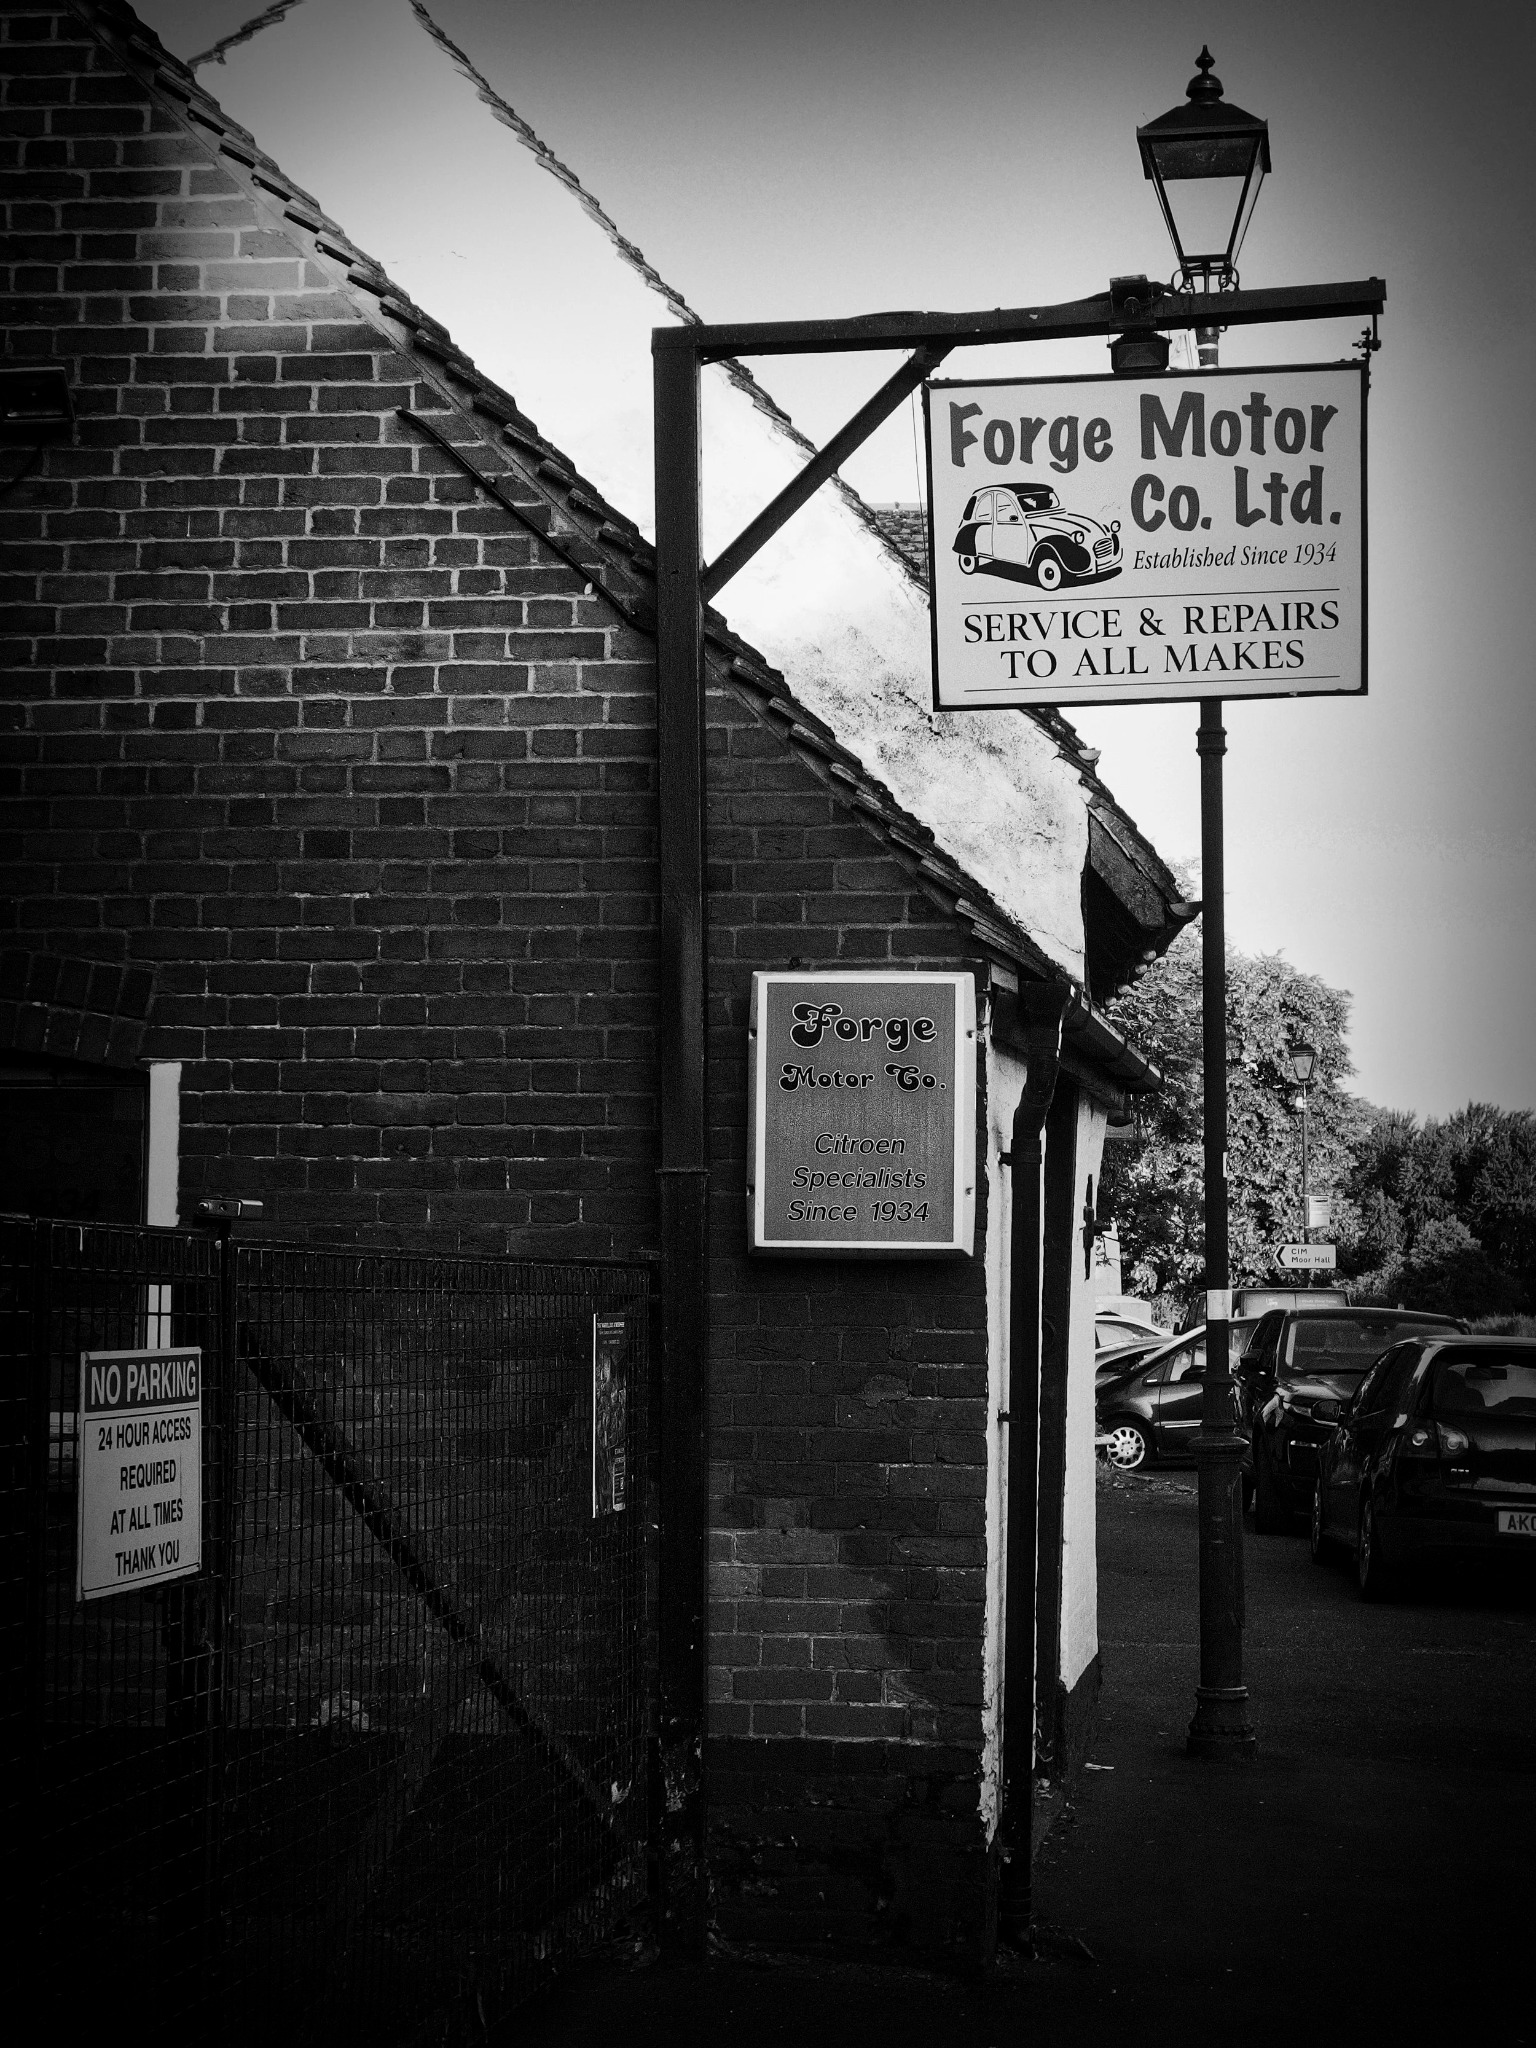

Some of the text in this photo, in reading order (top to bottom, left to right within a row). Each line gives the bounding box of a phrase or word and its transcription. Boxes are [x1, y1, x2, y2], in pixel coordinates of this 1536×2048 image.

[949, 390, 1339, 473] Forge Motor
[1130, 465, 1342, 532] Co. Ltd.
[1131, 542, 1337, 571] Established Since 1934
[963, 600, 1340, 643] SERVICE & REPAIRS
[1000, 639, 1305, 679] TO ALL MAKES
[790, 1002, 937, 1052] Forge
[779, 1063, 947, 1092] Motor Co.
[814, 1132, 906, 1155] Citroen
[791, 1165, 927, 1192] Specialists
[787, 1200, 929, 1222] Since 1934
[91, 1359, 196, 1405] NO PARKING
[98, 1416, 192, 1451] 24 HOUR ACCESS
[120, 1459, 176, 1491] REQUIRED
[110, 1497, 183, 1536] AT ALL TIMES
[115, 1539, 180, 1576] THANK YOU
